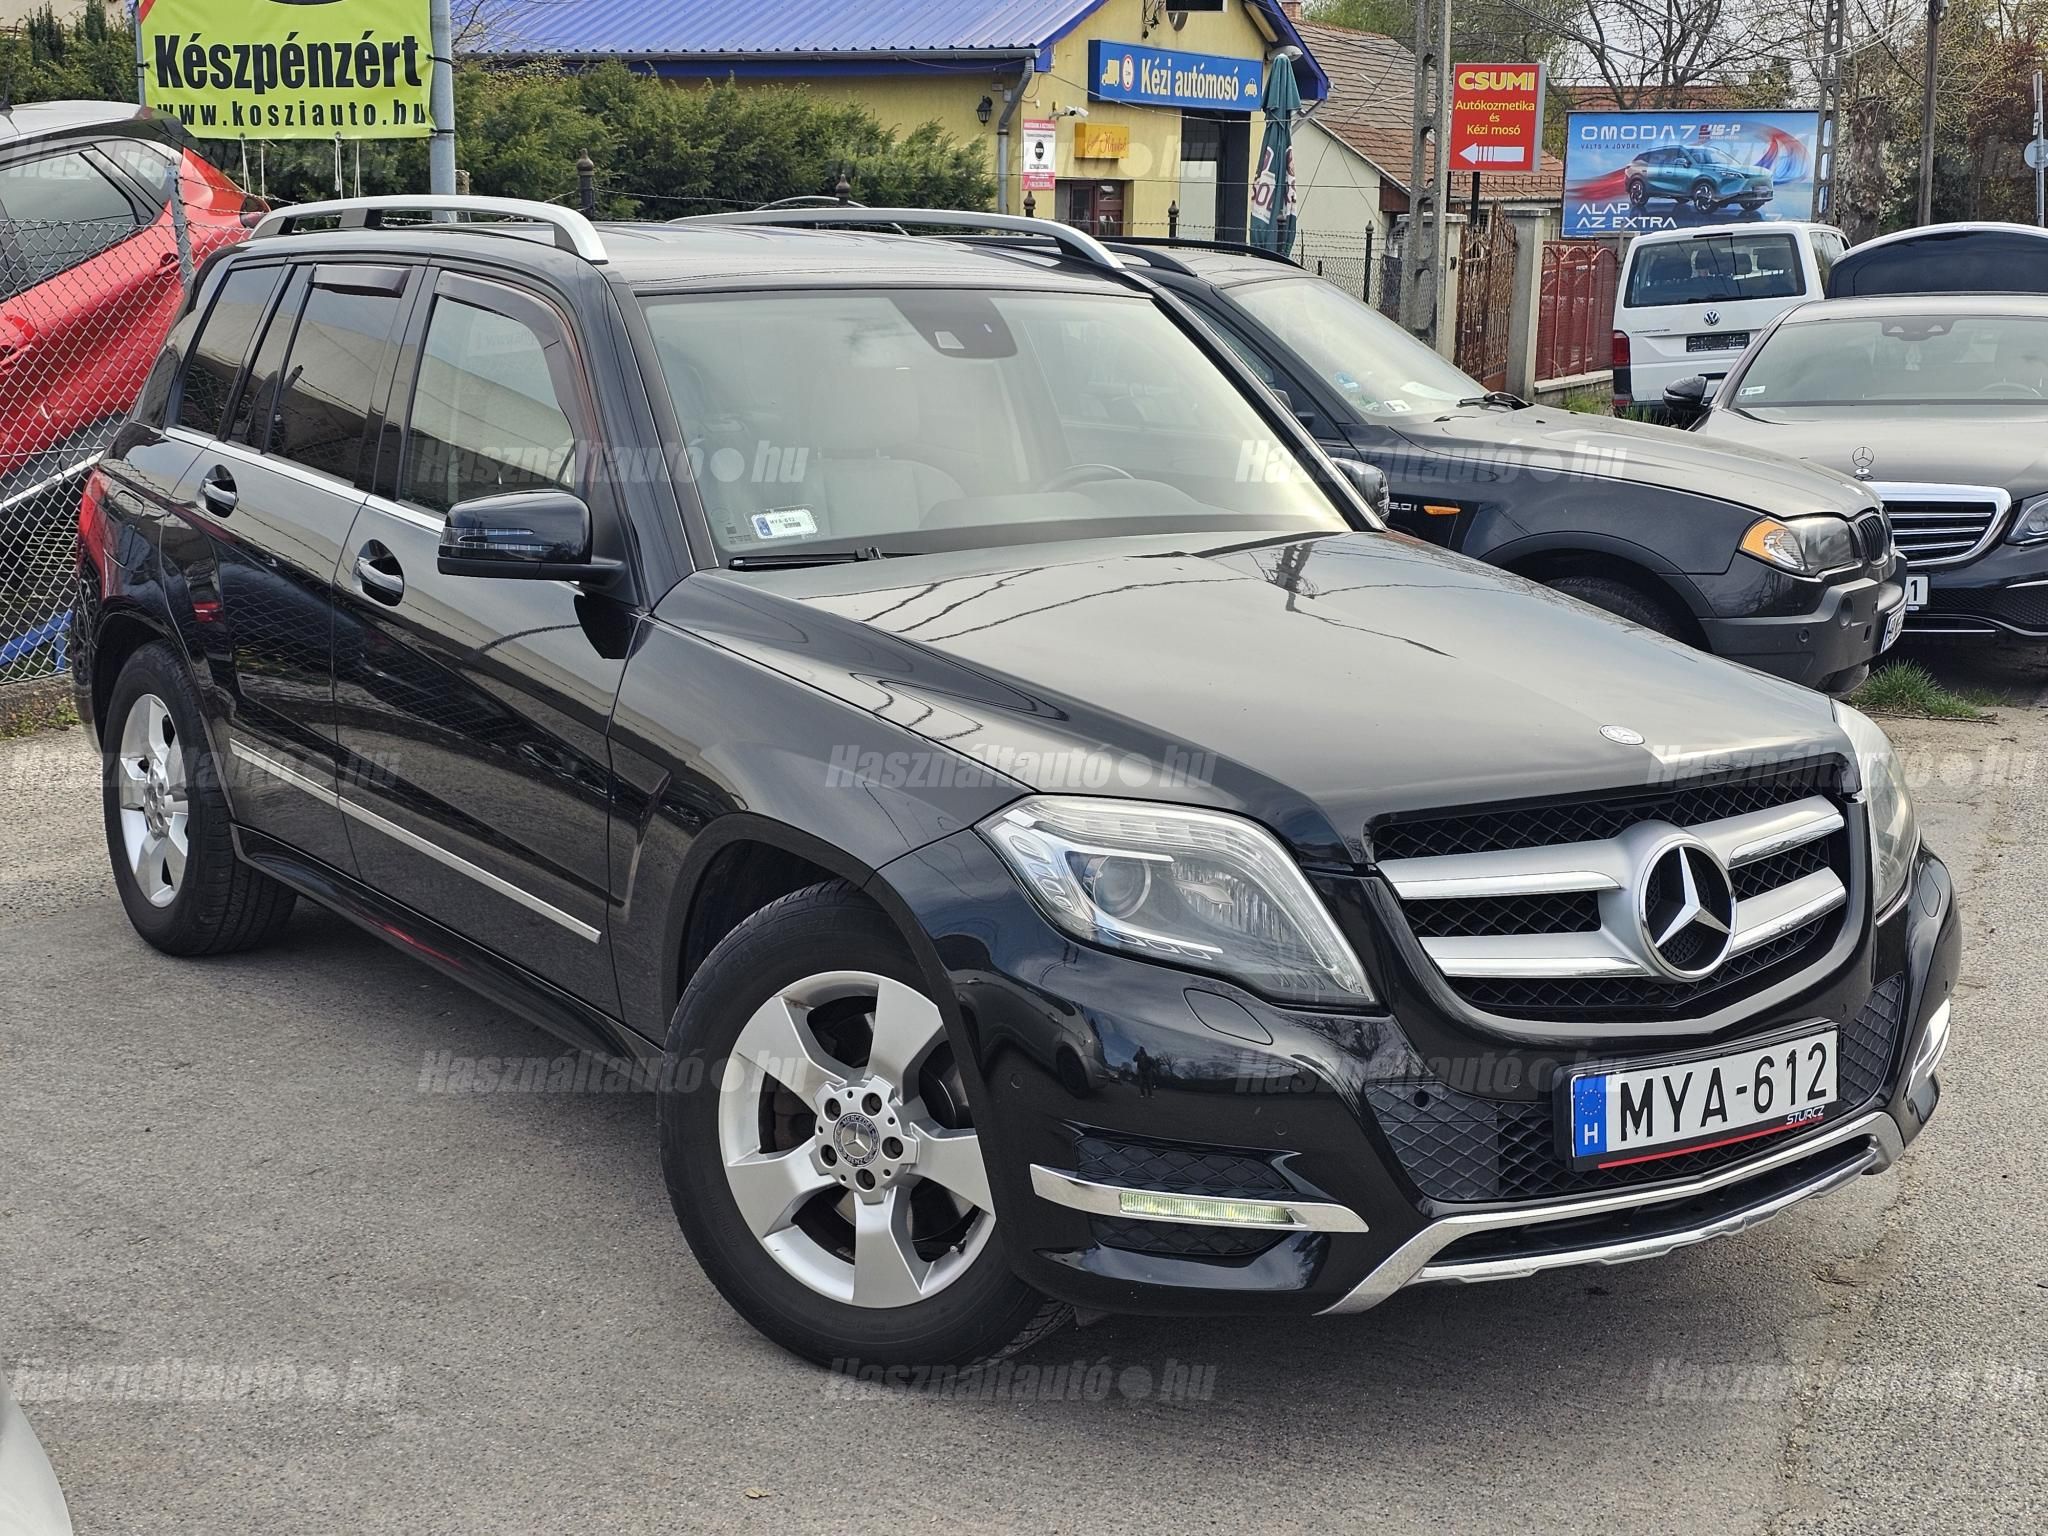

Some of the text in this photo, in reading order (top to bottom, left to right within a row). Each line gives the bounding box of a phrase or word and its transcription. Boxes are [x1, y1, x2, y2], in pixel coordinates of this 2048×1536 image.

[154, 30, 422, 95] Készpénzért
[1141, 57, 1239, 101] Kézi autómosó
[1458, 71, 1535, 91] CSUMI
[1455, 100, 1535, 111] Autókozmetika
[1489, 113, 1500, 123] és
[1467, 124, 1521, 135] Kézi mosó
[1581, 125, 1675, 140] OMODA
[1680, 125, 1696, 140] 7
[1577, 203, 1630, 215] ALAP
[1576, 216, 1677, 228] AZ EXTRA
[1619, 1042, 1828, 1142] MYA-612
[1786, 1105, 1825, 1125] STURCZ
[1583, 1123, 1598, 1146] H
